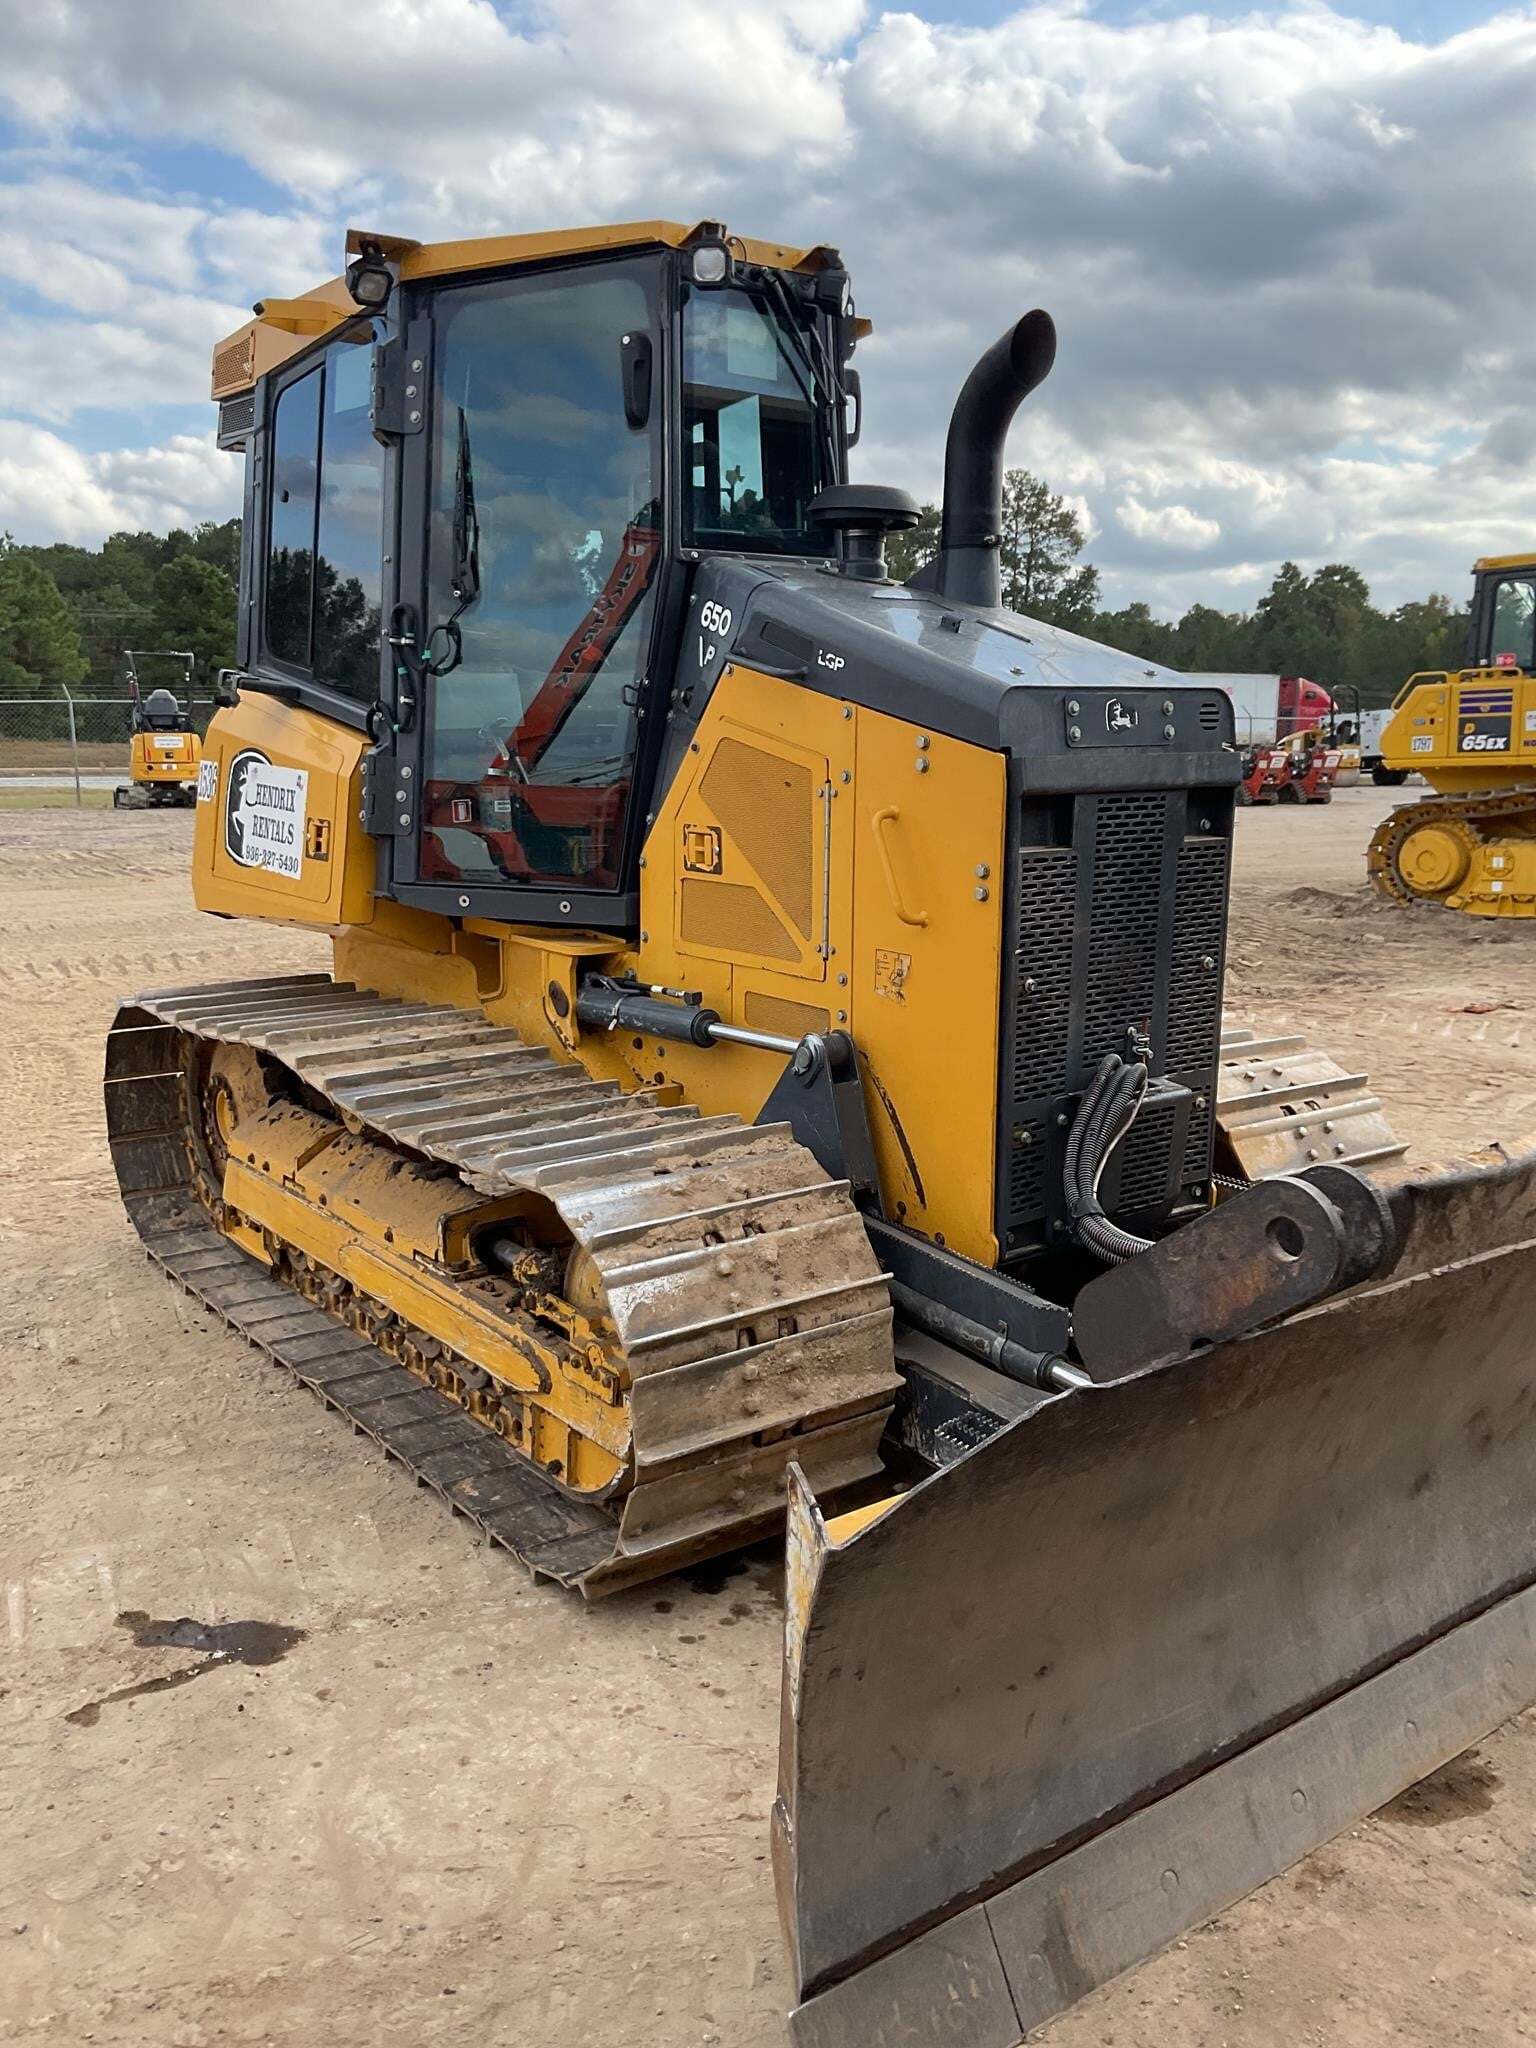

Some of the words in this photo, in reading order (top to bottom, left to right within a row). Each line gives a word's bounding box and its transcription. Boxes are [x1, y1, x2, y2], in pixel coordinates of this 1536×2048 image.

[701, 601, 732, 636] 650
[818, 650, 845, 671] LGP
[1462, 735, 1507, 750] 65EX
[1464, 723, 1476, 734] D
[256, 783, 296, 812] HENDRIX
[252, 815, 294, 845] RENTALS
[245, 845, 299, 873] 936-327-5430
